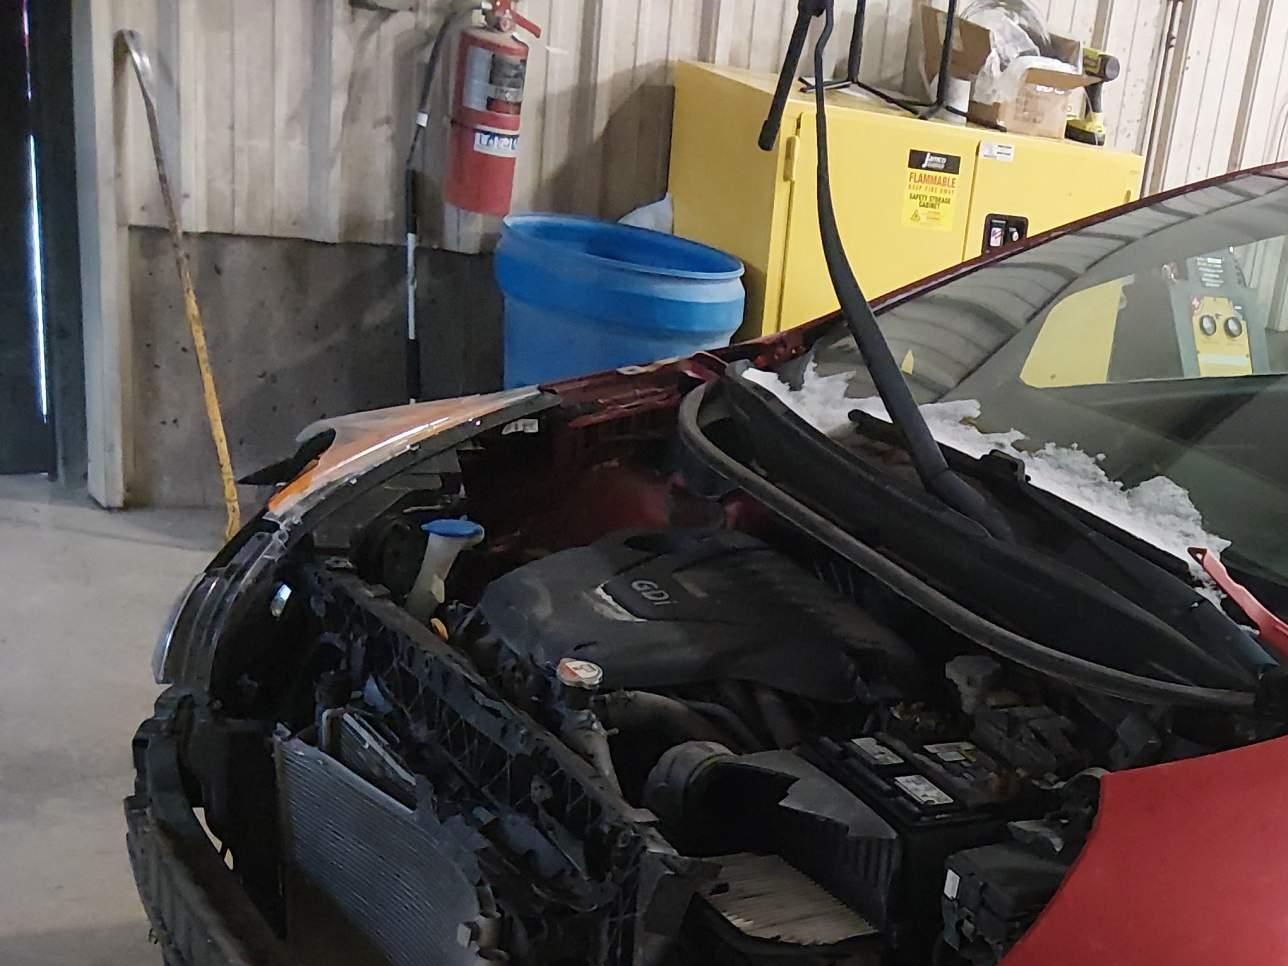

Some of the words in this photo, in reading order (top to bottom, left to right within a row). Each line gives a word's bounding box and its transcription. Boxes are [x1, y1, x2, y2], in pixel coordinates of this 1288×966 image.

[909, 172, 957, 188] FLAMMABLE
[909, 193, 928, 202] SAFETY
[929, 196, 951, 205] STORAGE
[918, 201, 941, 209] CABINET
